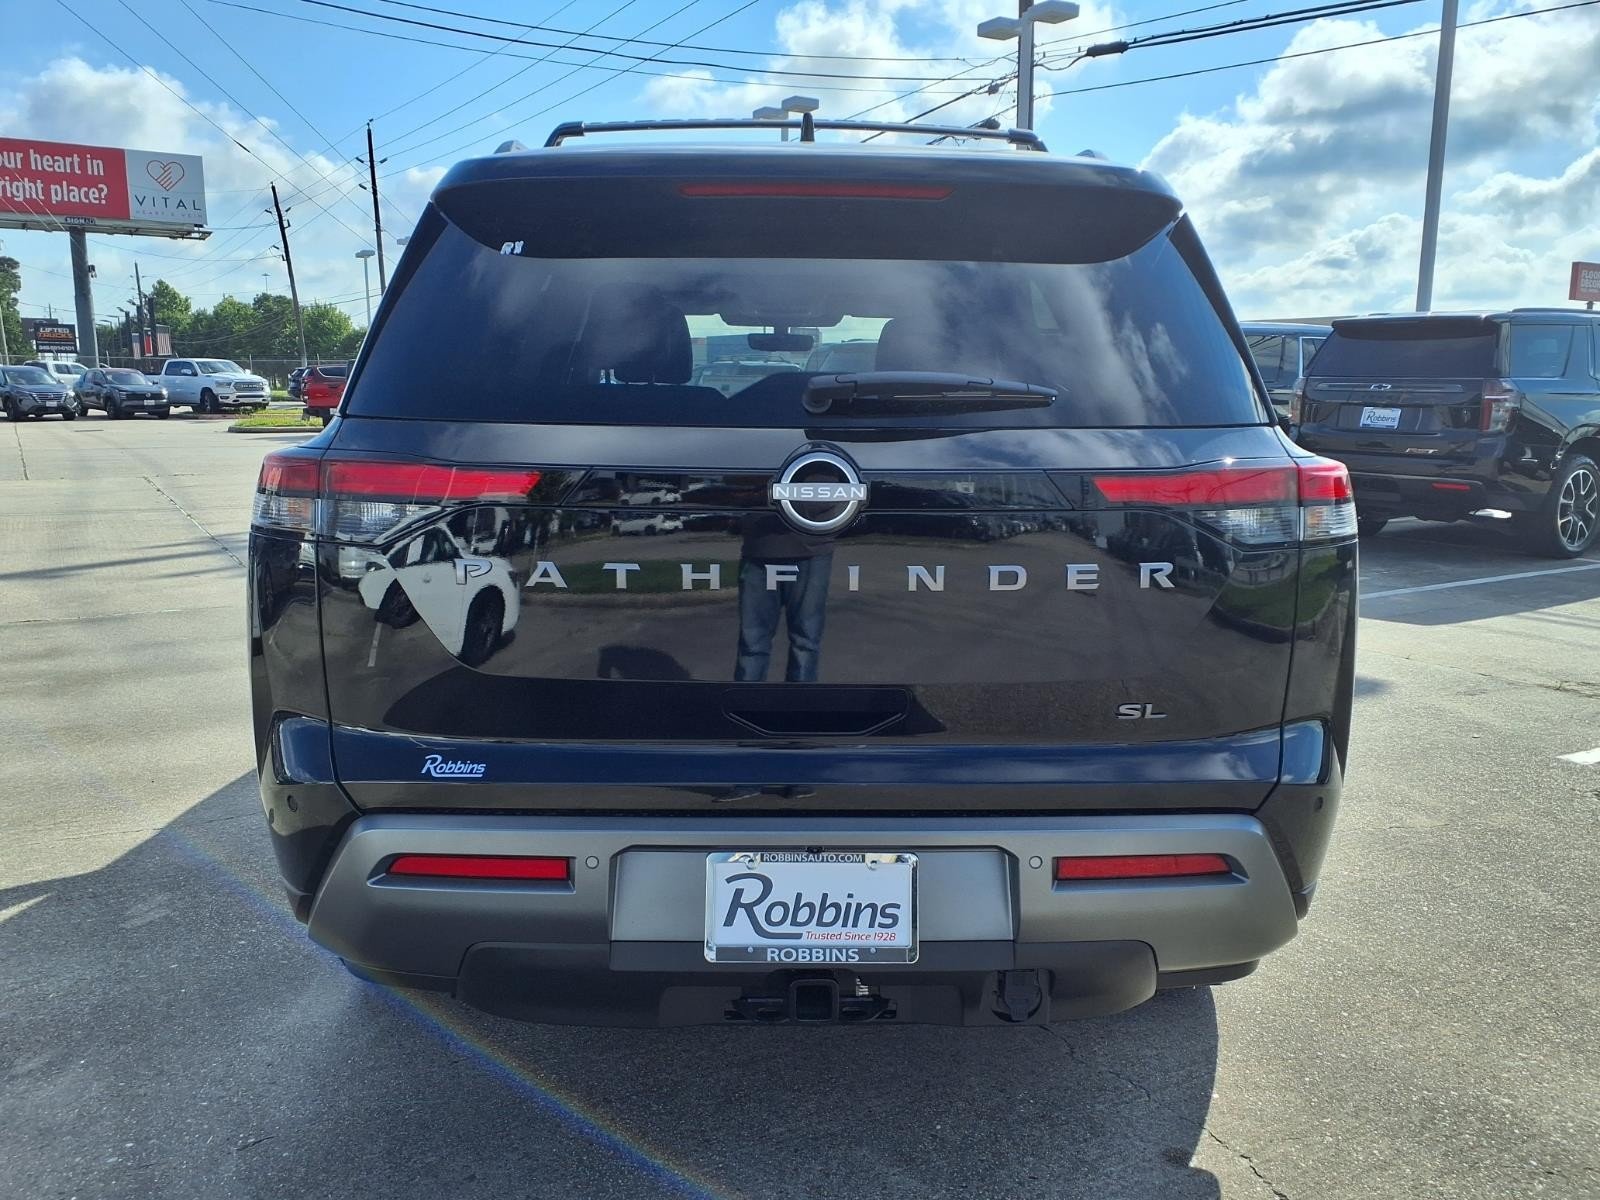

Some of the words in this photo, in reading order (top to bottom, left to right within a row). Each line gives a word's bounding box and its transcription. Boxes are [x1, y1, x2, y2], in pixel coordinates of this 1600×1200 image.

[0, 151, 24, 169] ur
[29, 148, 81, 175] heart
[87, 154, 104, 176] in
[0, 175, 44, 202] right
[50, 180, 108, 205] place?
[134, 194, 202, 211] VITAL
[1366, 411, 1397, 423] Robbins
[775, 486, 864, 498] NISSAN
[454, 557, 1175, 592] PATHFINDER
[1116, 703, 1167, 720] SL
[421, 754, 486, 778] Robbins
[763, 853, 863, 864] ROBBINSAUTO.COM
[723, 872, 901, 939] Robbins
[805, 931, 842, 941] Trusted
[844, 932, 872, 941] Since
[873, 932, 896, 942] 1928
[767, 948, 860, 962] ROBBINS
